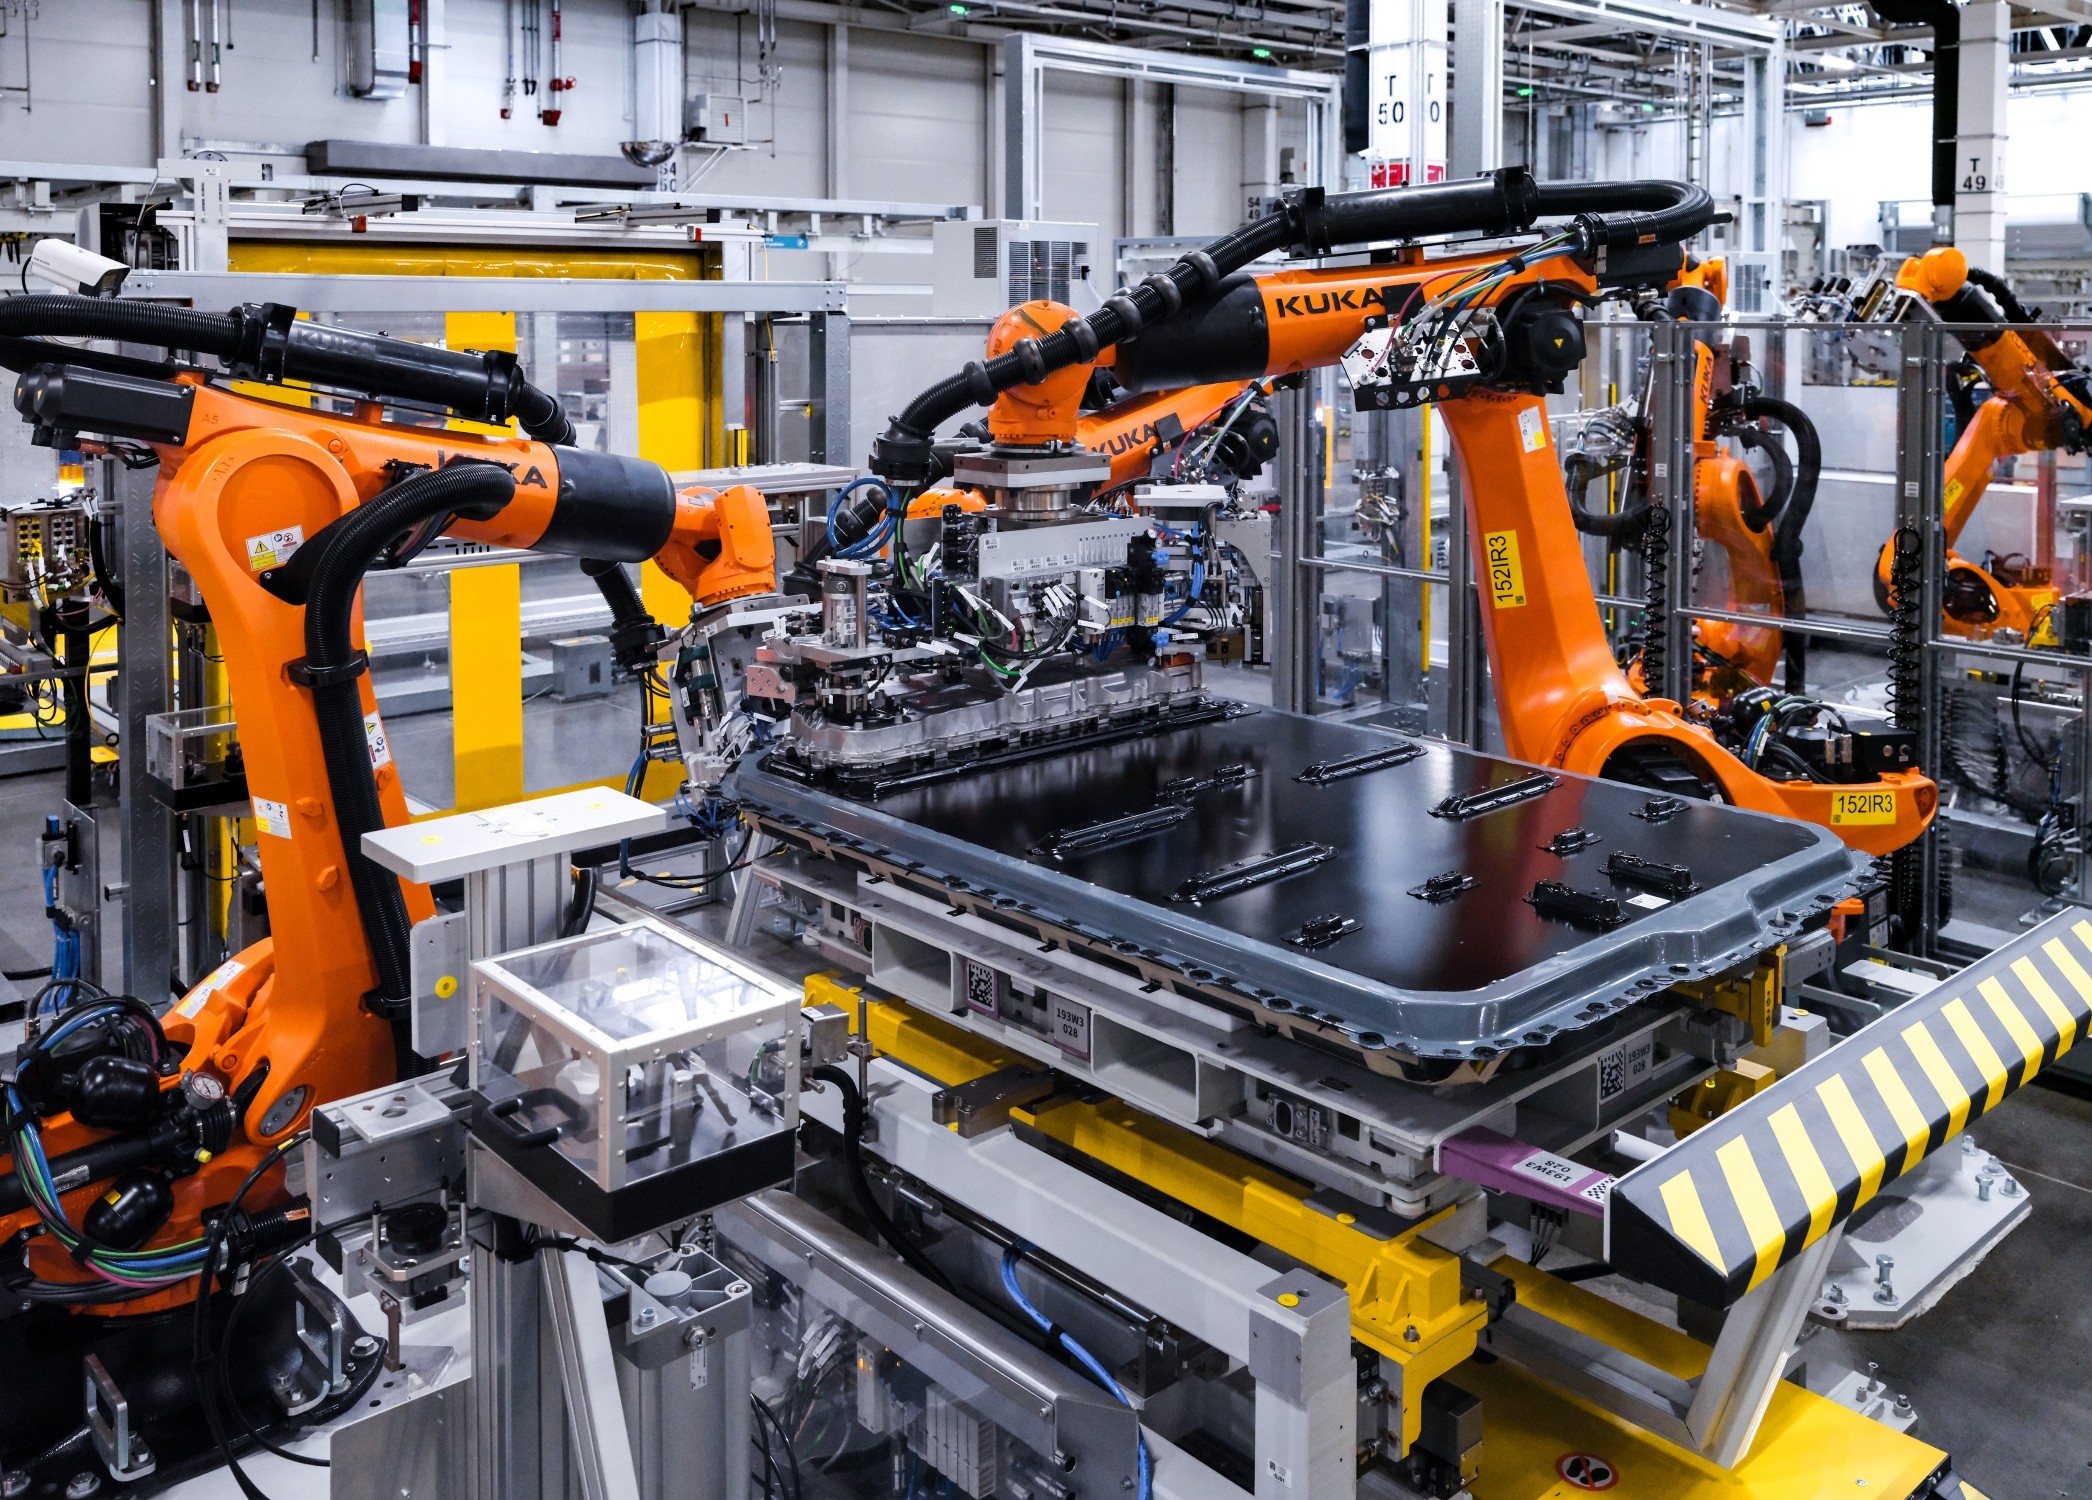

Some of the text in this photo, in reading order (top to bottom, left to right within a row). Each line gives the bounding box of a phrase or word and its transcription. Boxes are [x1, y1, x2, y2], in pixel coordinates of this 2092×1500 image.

[1385, 75, 1397, 97] T
[1378, 101, 1404, 125] 50
[1969, 158, 1981, 173] T
[1963, 175, 1987, 191] 49
[1248, 196, 1261, 208] S4
[1275, 287, 1387, 318] KUKA
[1488, 535, 1514, 602] 152IR3
[1838, 794, 1894, 814] 152IR3
[1056, 1007, 1085, 1027] 193W3
[1062, 1023, 1079, 1038] 028
[1628, 1043, 1651, 1063] 193W3
[1632, 1059, 1646, 1075] 028
[1525, 1161, 1573, 1182] 193W3
[1544, 1160, 1572, 1173] 028
